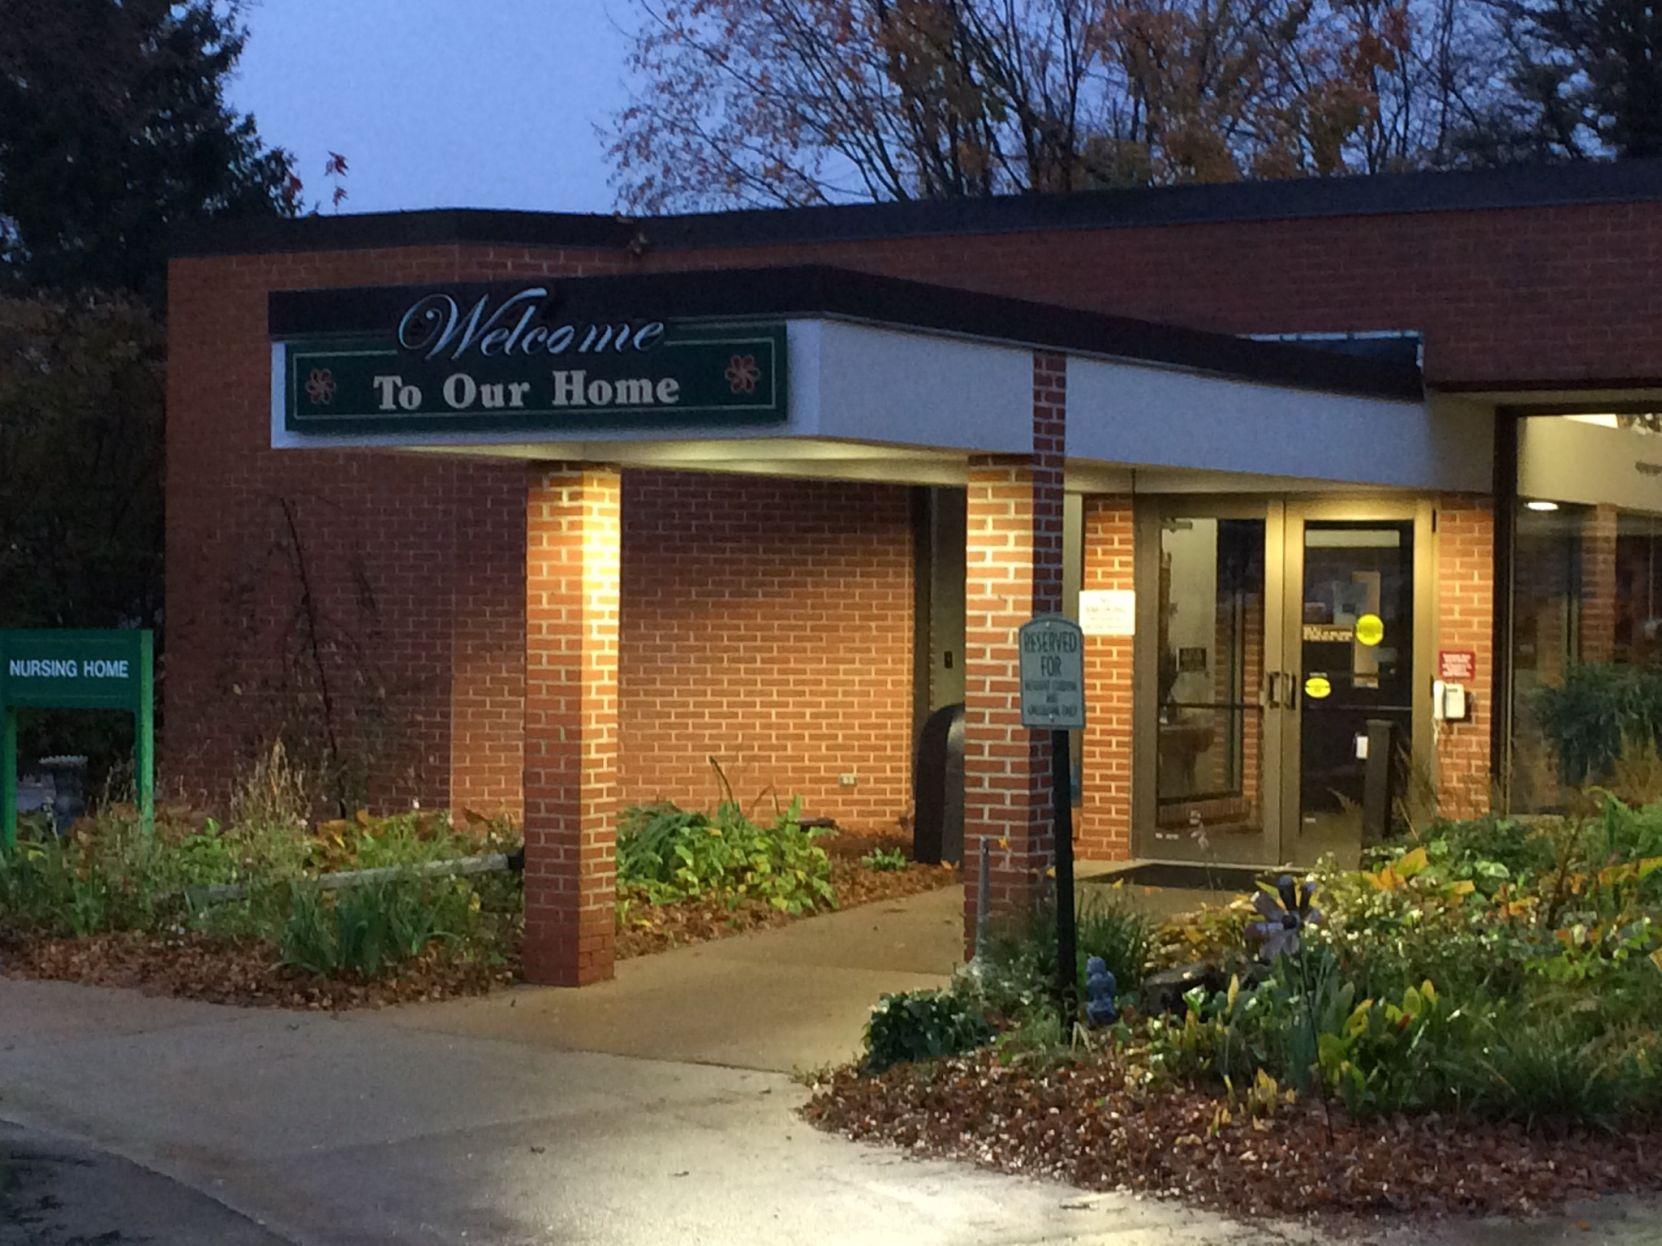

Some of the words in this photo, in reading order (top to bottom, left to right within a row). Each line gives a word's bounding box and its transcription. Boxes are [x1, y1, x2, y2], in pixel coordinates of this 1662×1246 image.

[398, 287, 665, 361] Welcome
[373, 374, 423, 410] To
[442, 371, 530, 410] Our
[552, 368, 680, 407] Home
[1023, 631, 1077, 653] RESERVED
[9, 659, 78, 677] NURSING
[83, 660, 129, 678] HOME
[1040, 655, 1062, 677] FOR
